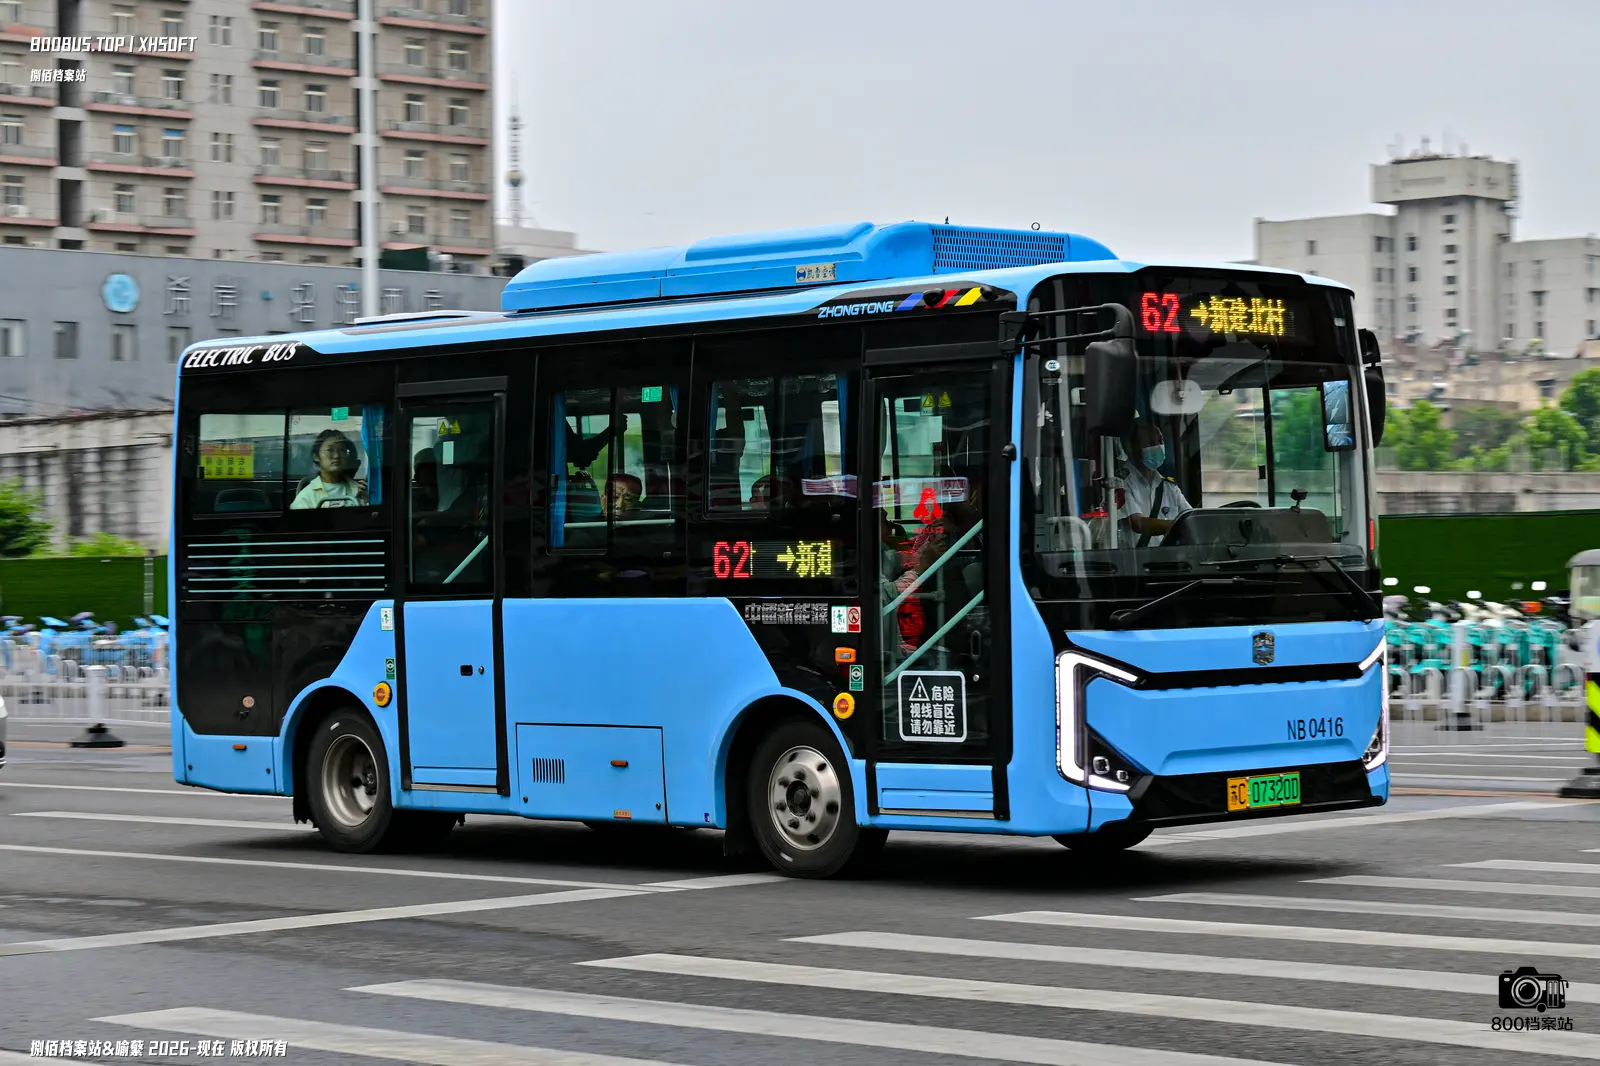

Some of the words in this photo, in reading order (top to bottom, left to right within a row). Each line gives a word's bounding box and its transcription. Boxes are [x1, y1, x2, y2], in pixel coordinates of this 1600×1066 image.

[817, 301, 894, 319] ZHONGTONG
[1141, 292, 1181, 332] 62
[1208, 296, 1286, 336] 新建北村
[184, 345, 262, 369] ELECTRIC
[261, 342, 301, 362] BUS
[713, 541, 751, 578] 62
[931, 685, 955, 702] 危险
[910, 703, 955, 719] 视线盲区
[910, 719, 956, 736] 请勿靠近
